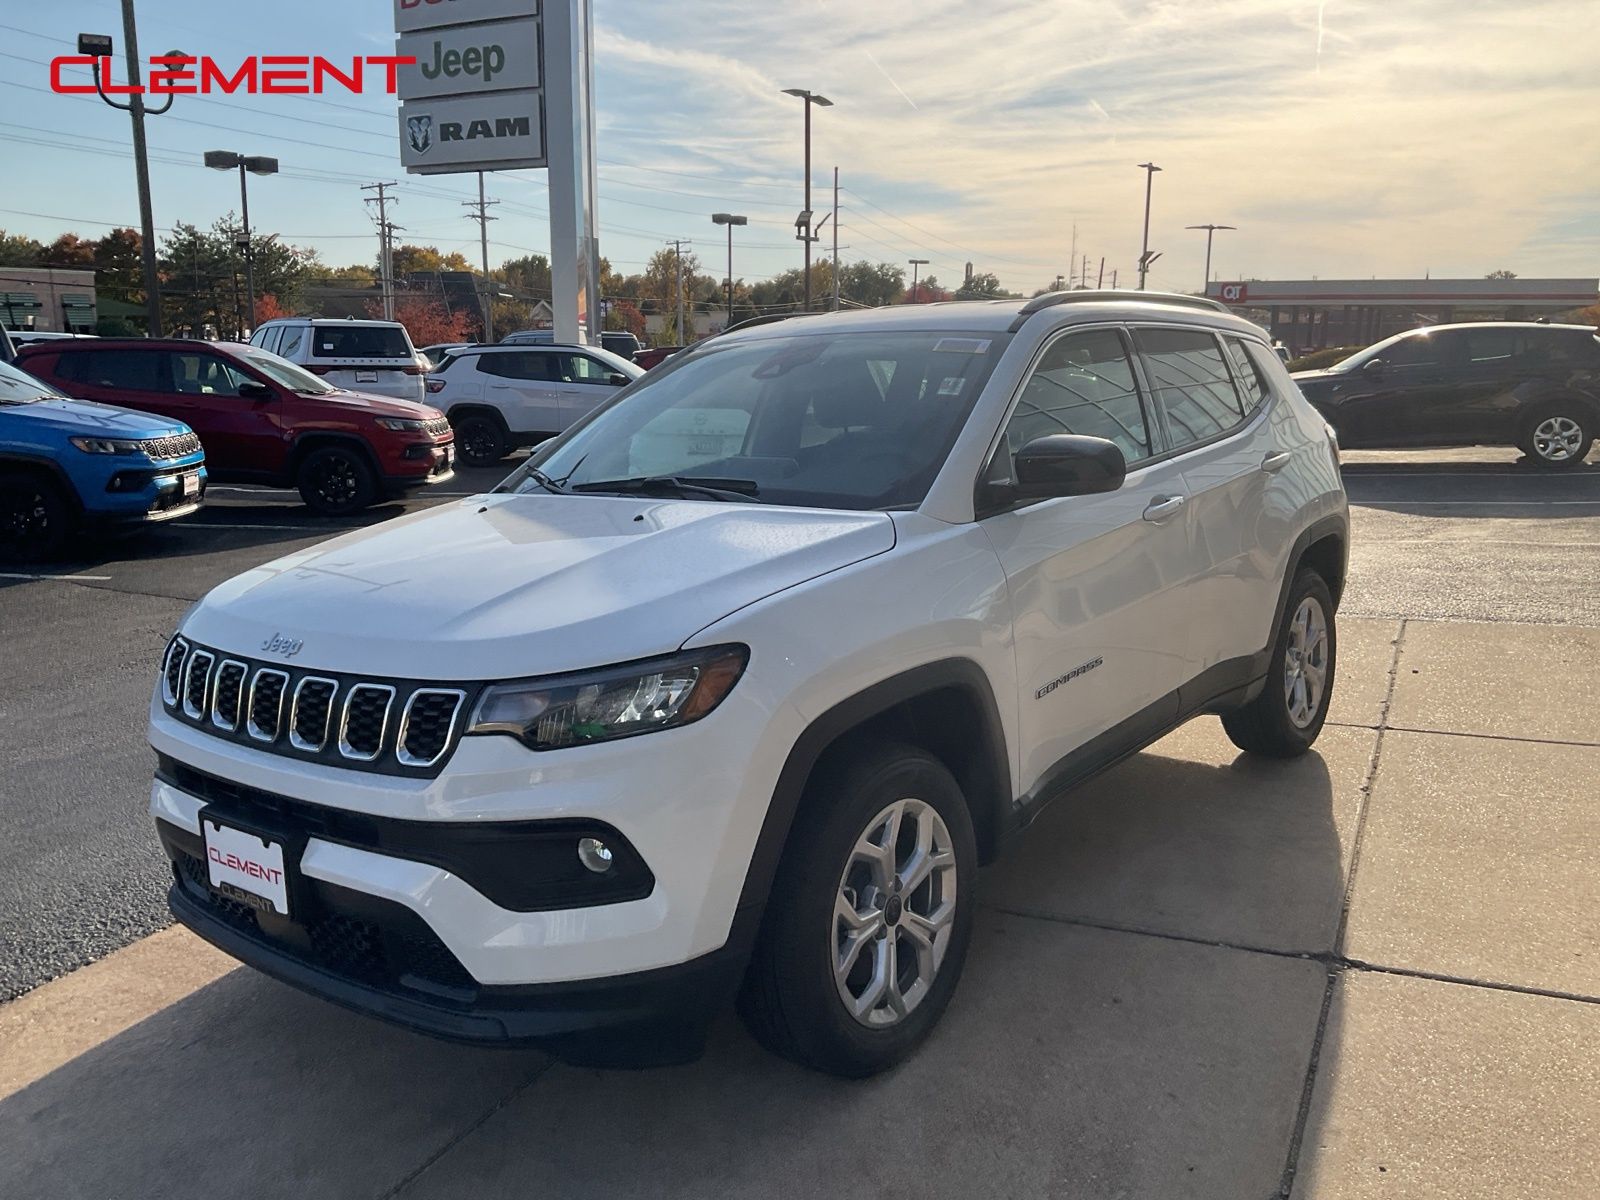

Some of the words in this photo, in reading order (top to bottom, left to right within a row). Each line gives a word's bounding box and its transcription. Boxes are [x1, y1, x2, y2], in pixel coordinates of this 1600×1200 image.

[421, 41, 505, 81] Jeep
[440, 117, 529, 141] RAM
[1223, 285, 1242, 300] QT
[261, 632, 304, 658] Jeep
[1035, 655, 1103, 699] COMPASS
[209, 847, 282, 884] CLEMENT
[221, 884, 271, 912] CLEMENT
